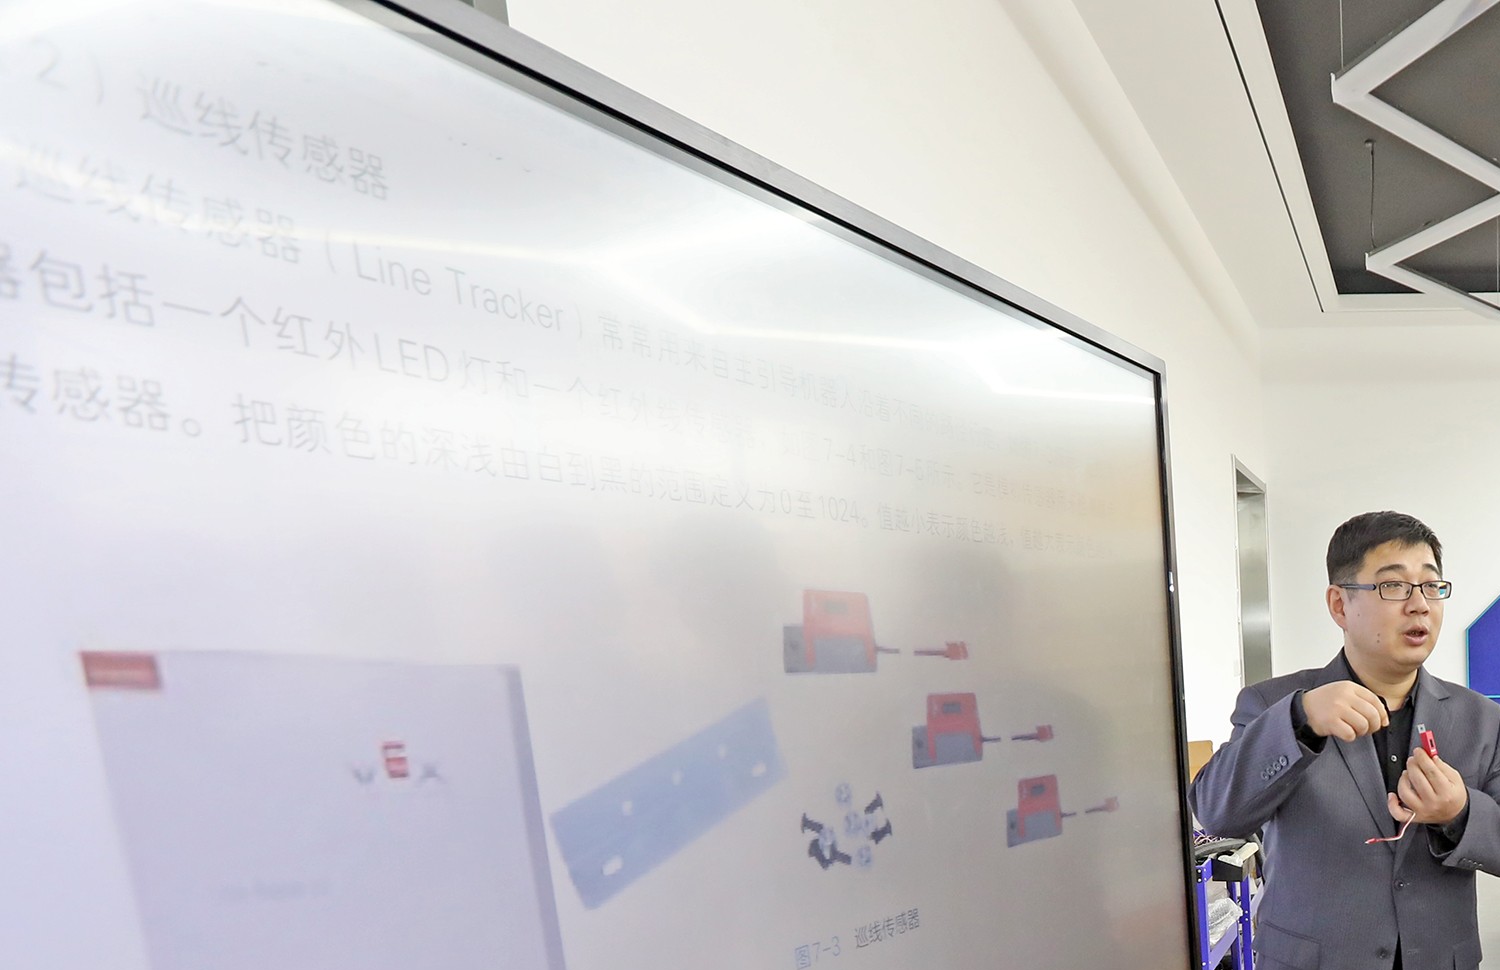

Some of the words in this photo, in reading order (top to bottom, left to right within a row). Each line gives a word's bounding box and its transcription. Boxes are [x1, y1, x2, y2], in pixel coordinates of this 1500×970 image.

[794, 935, 842, 970] 图7-3
[853, 907, 921, 950] 巡线传感器
